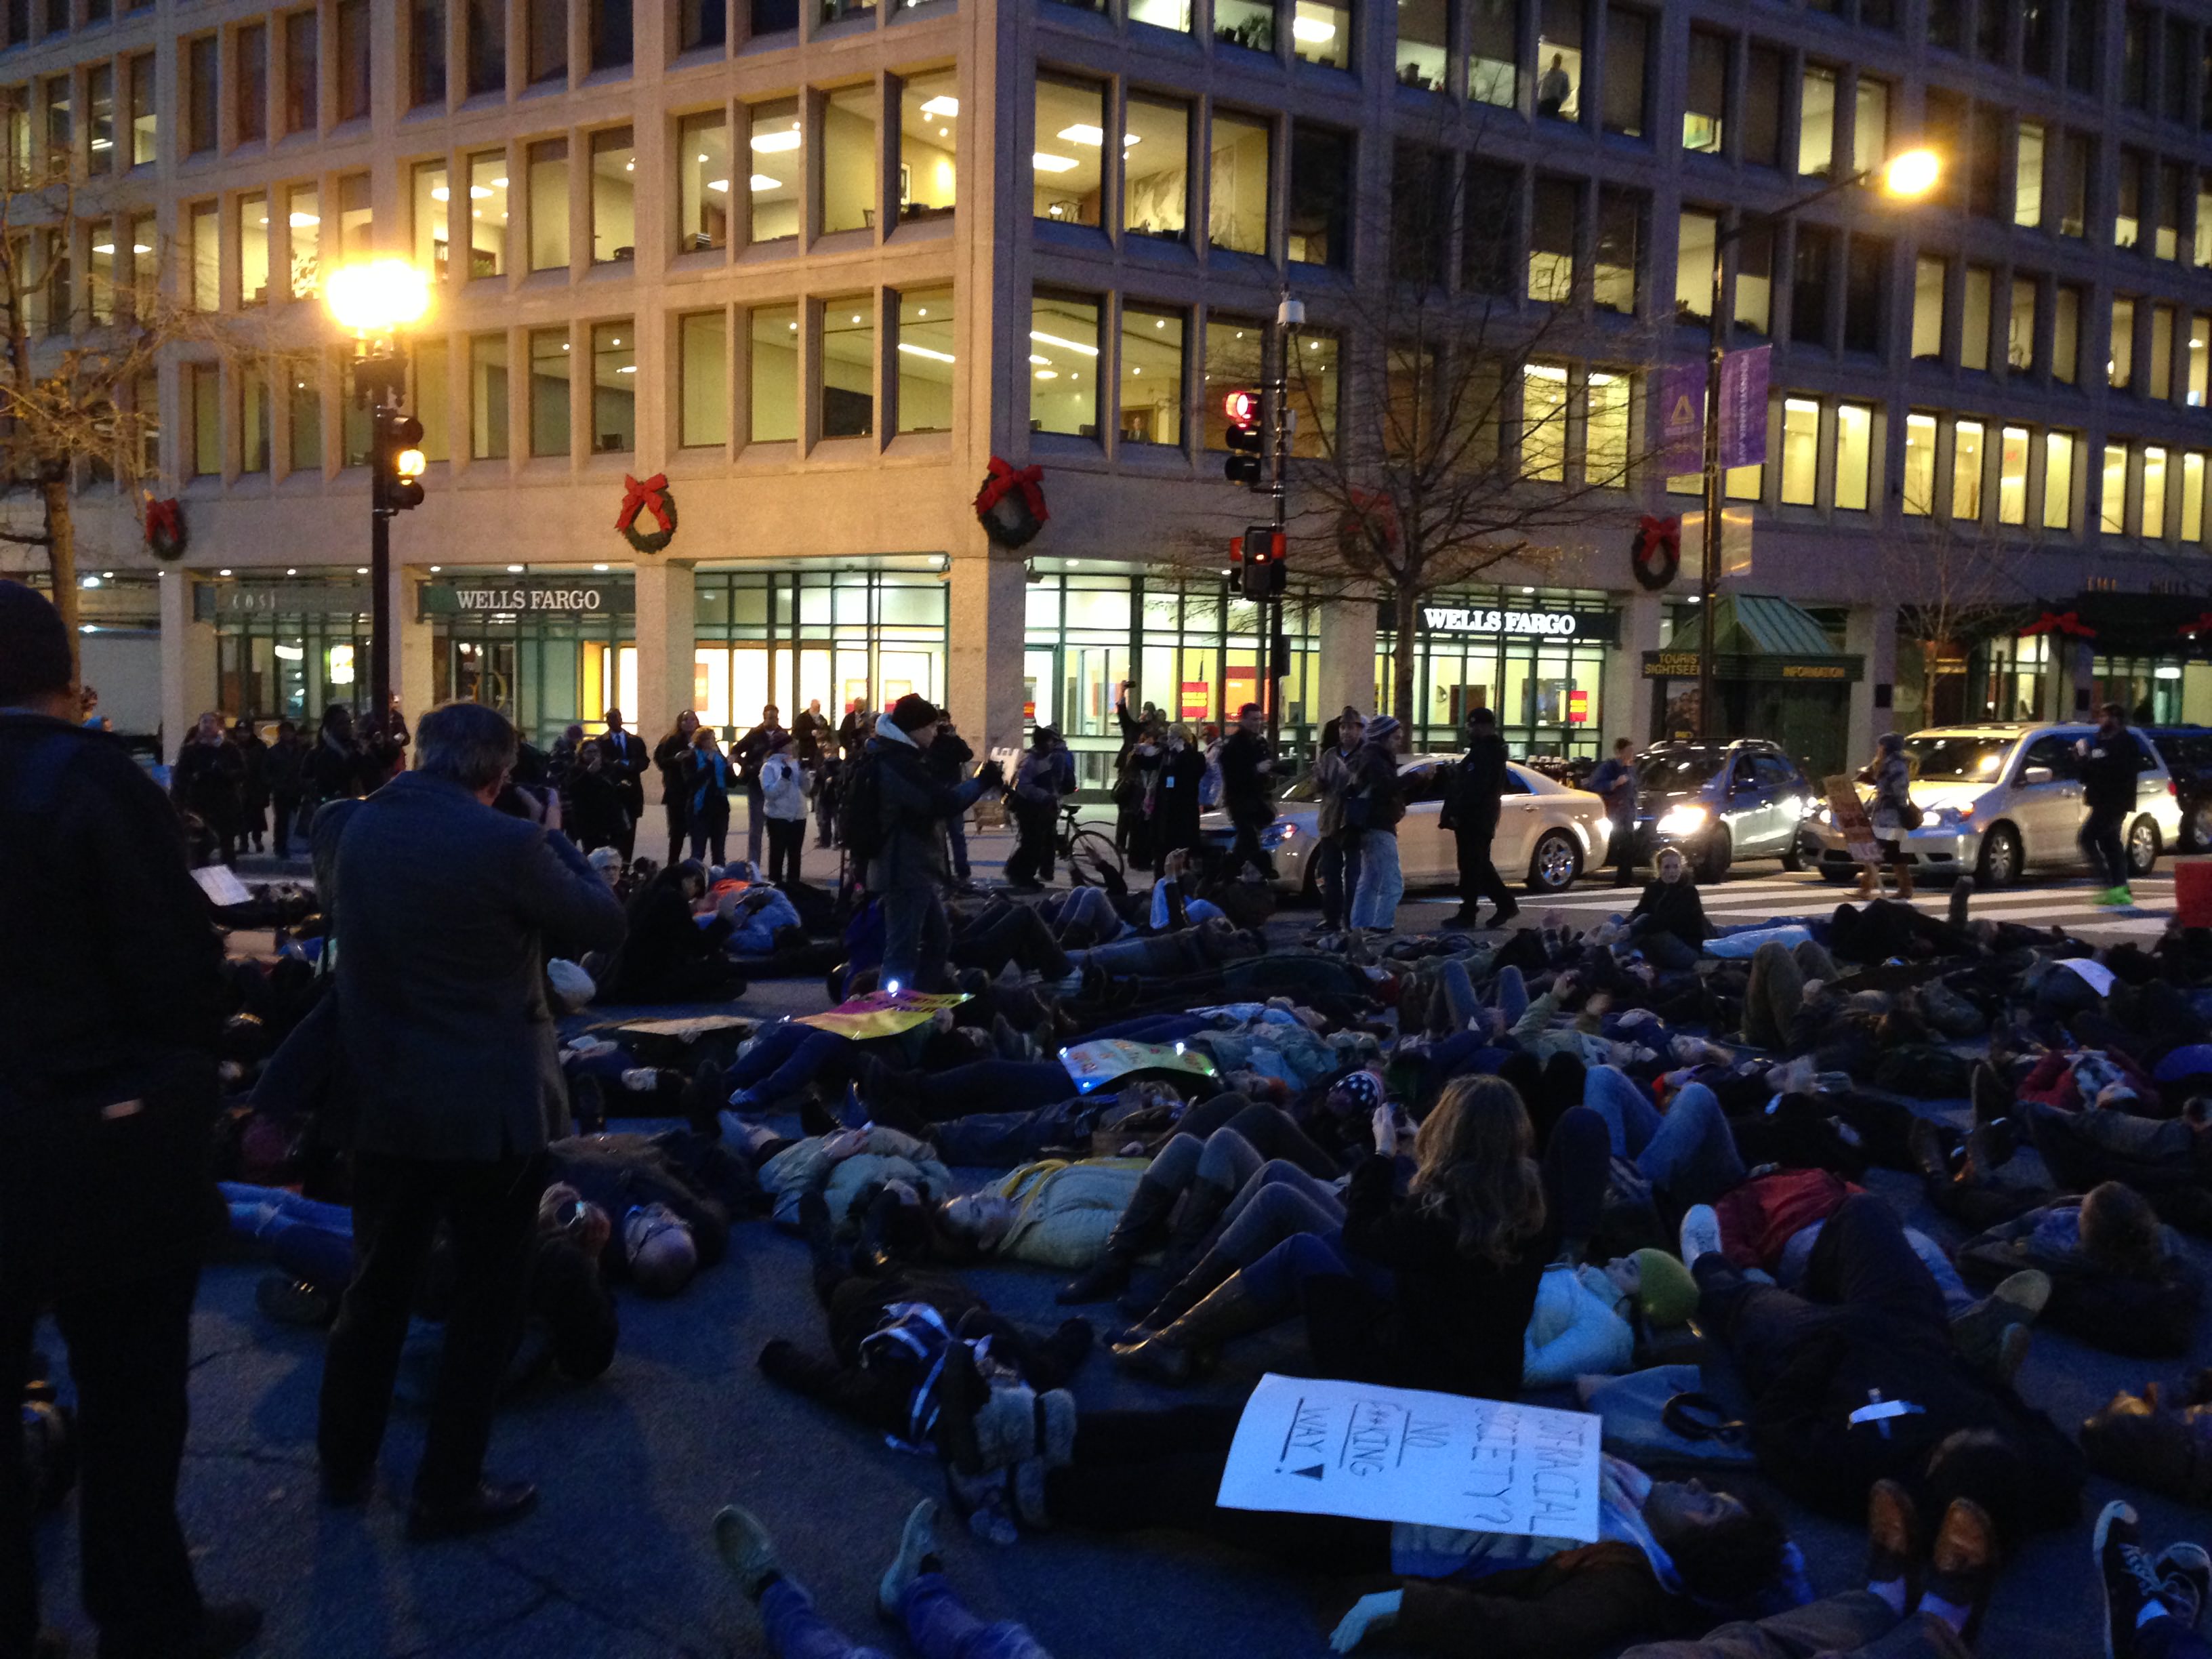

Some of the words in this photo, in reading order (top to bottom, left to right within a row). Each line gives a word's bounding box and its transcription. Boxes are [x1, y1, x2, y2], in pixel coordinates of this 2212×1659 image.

[457, 590, 525, 610] WELLS
[531, 590, 601, 609] FARGO
[1424, 608, 1502, 632] WELLS
[1504, 613, 1576, 635] FARGO
[1404, 1419, 1450, 1449] NO
